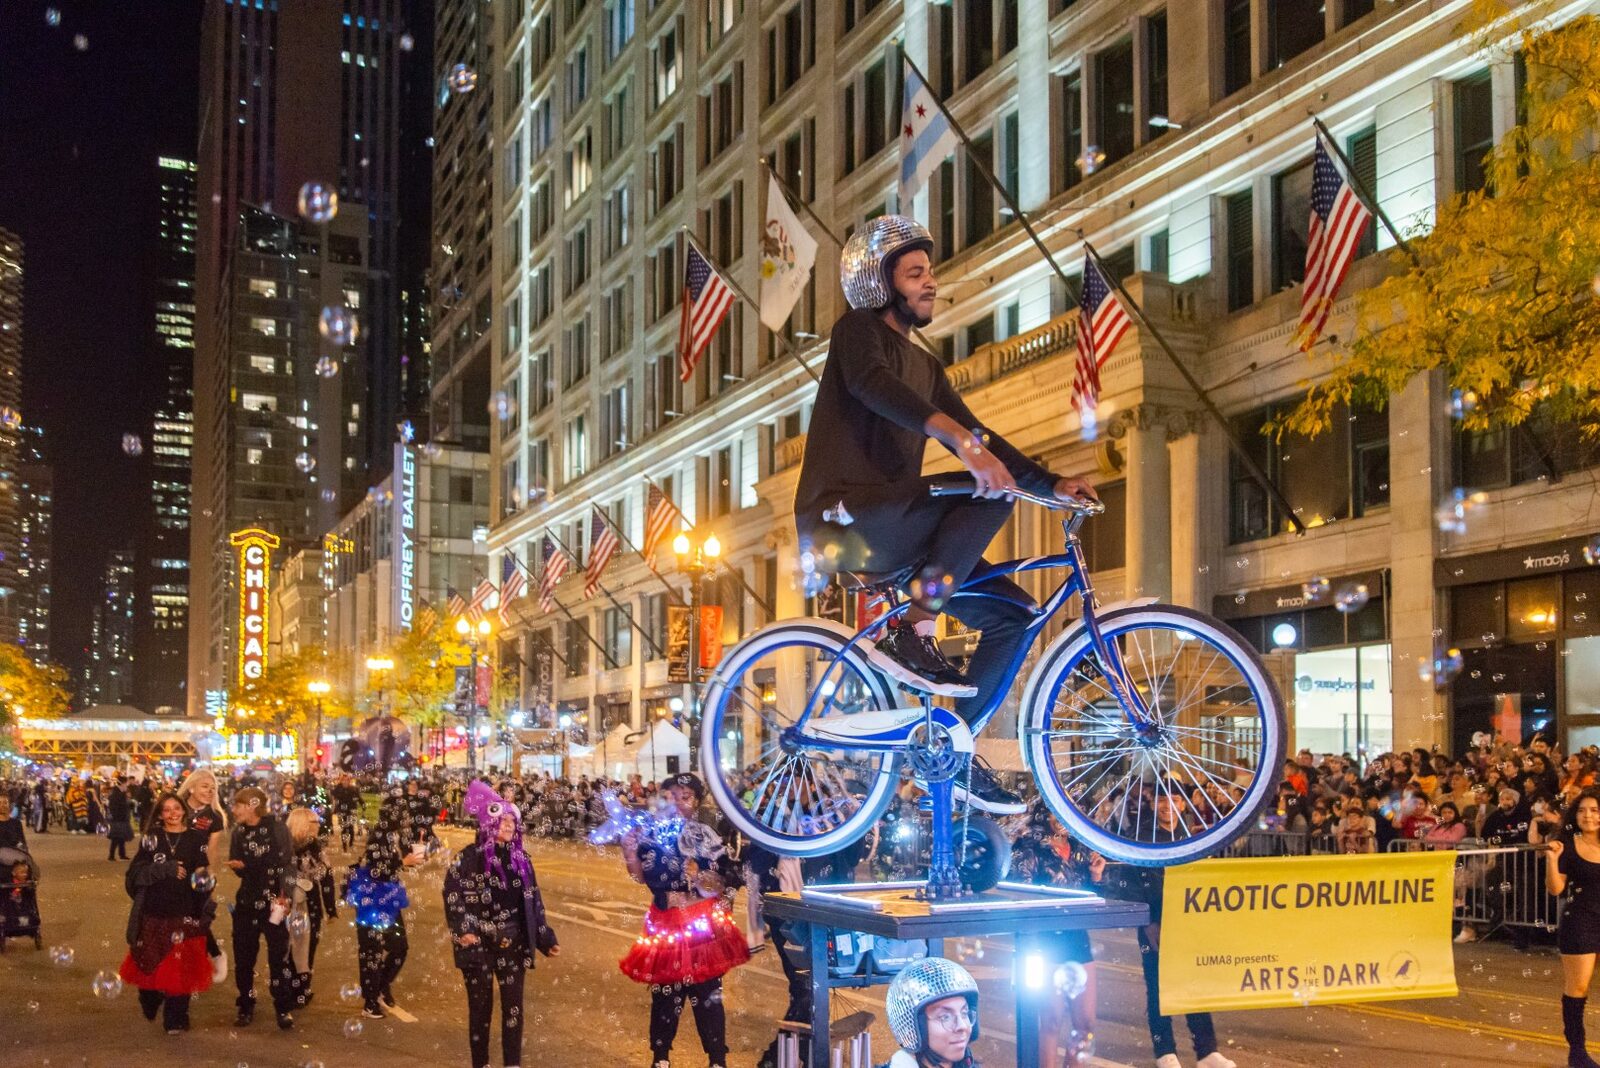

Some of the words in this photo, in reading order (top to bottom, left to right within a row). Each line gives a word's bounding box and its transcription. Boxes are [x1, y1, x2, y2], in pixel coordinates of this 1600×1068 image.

[402, 447, 415, 528] BALLET
[1535, 551, 1570, 569] macy's
[400, 534, 414, 632] JOFFREY
[1184, 883, 1288, 914] KAOTIC
[1295, 878, 1436, 909] DRUMLINE
[1234, 954, 1279, 966] presents:
[1240, 966, 1299, 992] ARTS
[1305, 966, 1316, 975] IN
[1323, 962, 1381, 986] DARK
[1304, 978, 1319, 987] THE
